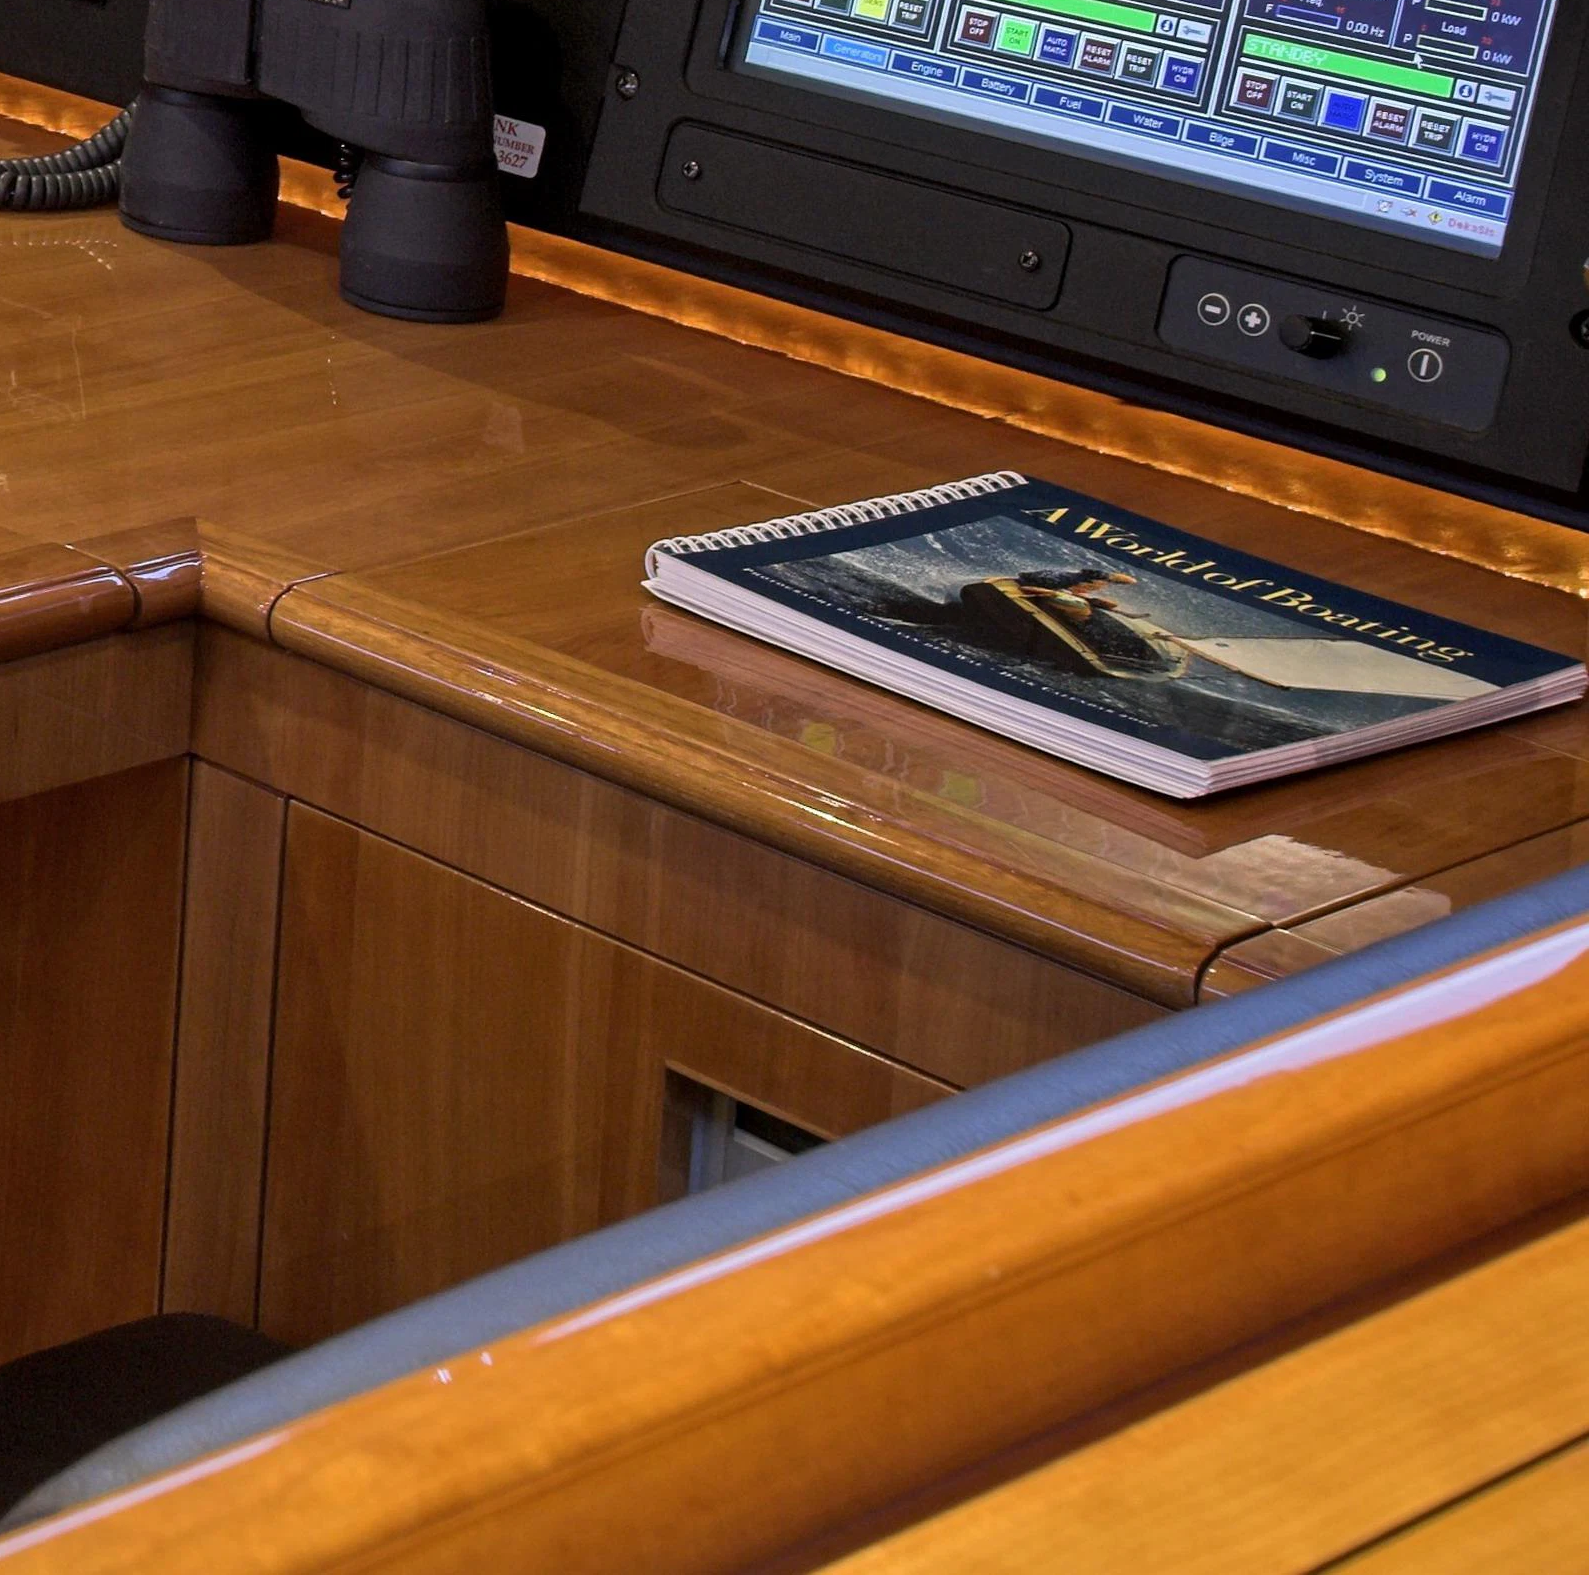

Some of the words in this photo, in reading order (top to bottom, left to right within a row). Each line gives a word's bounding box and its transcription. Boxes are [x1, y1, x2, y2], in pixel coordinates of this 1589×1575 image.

[899, 2, 923, 14] RESET
[901, 10, 918, 21] TRIP
[969, 17, 988, 29] STOP
[1442, 21, 1466, 36] Load
[970, 26, 984, 37] OFF
[1046, 35, 1067, 47] AUTO
[1086, 44, 1111, 58] RESET
[1245, 36, 1328, 66] STANDBY
[1083, 53, 1111, 66] ALARM
[1126, 53, 1152, 66] RESET
[1128, 62, 1146, 74] TRIP
[1245, 78, 1267, 93] STOP
[1245, 88, 1263, 101] OFF
[1286, 89, 1313, 104] START
[780, 30, 801, 43] Main
[833, 42, 884, 63] Generators
[911, 61, 943, 78] Engine
[981, 77, 1016, 96] Battery
[1059, 95, 1082, 111] Fuel
[1133, 113, 1165, 130] Water
[1209, 131, 1235, 150] Bilge
[1292, 150, 1316, 167] Misc
[1364, 167, 1404, 187] System
[1453, 189, 1487, 207] Alarm
[1375, 109, 1404, 124] RESET
[1421, 120, 1451, 135] RESET
[1423, 130, 1444, 143] TRIP
[1411, 329, 1451, 348] POWER
[1021, 507, 1069, 524] A
[1074, 517, 1213, 574] World
[1202, 572, 1274, 593] of
[1253, 586, 1474, 663] Boating
